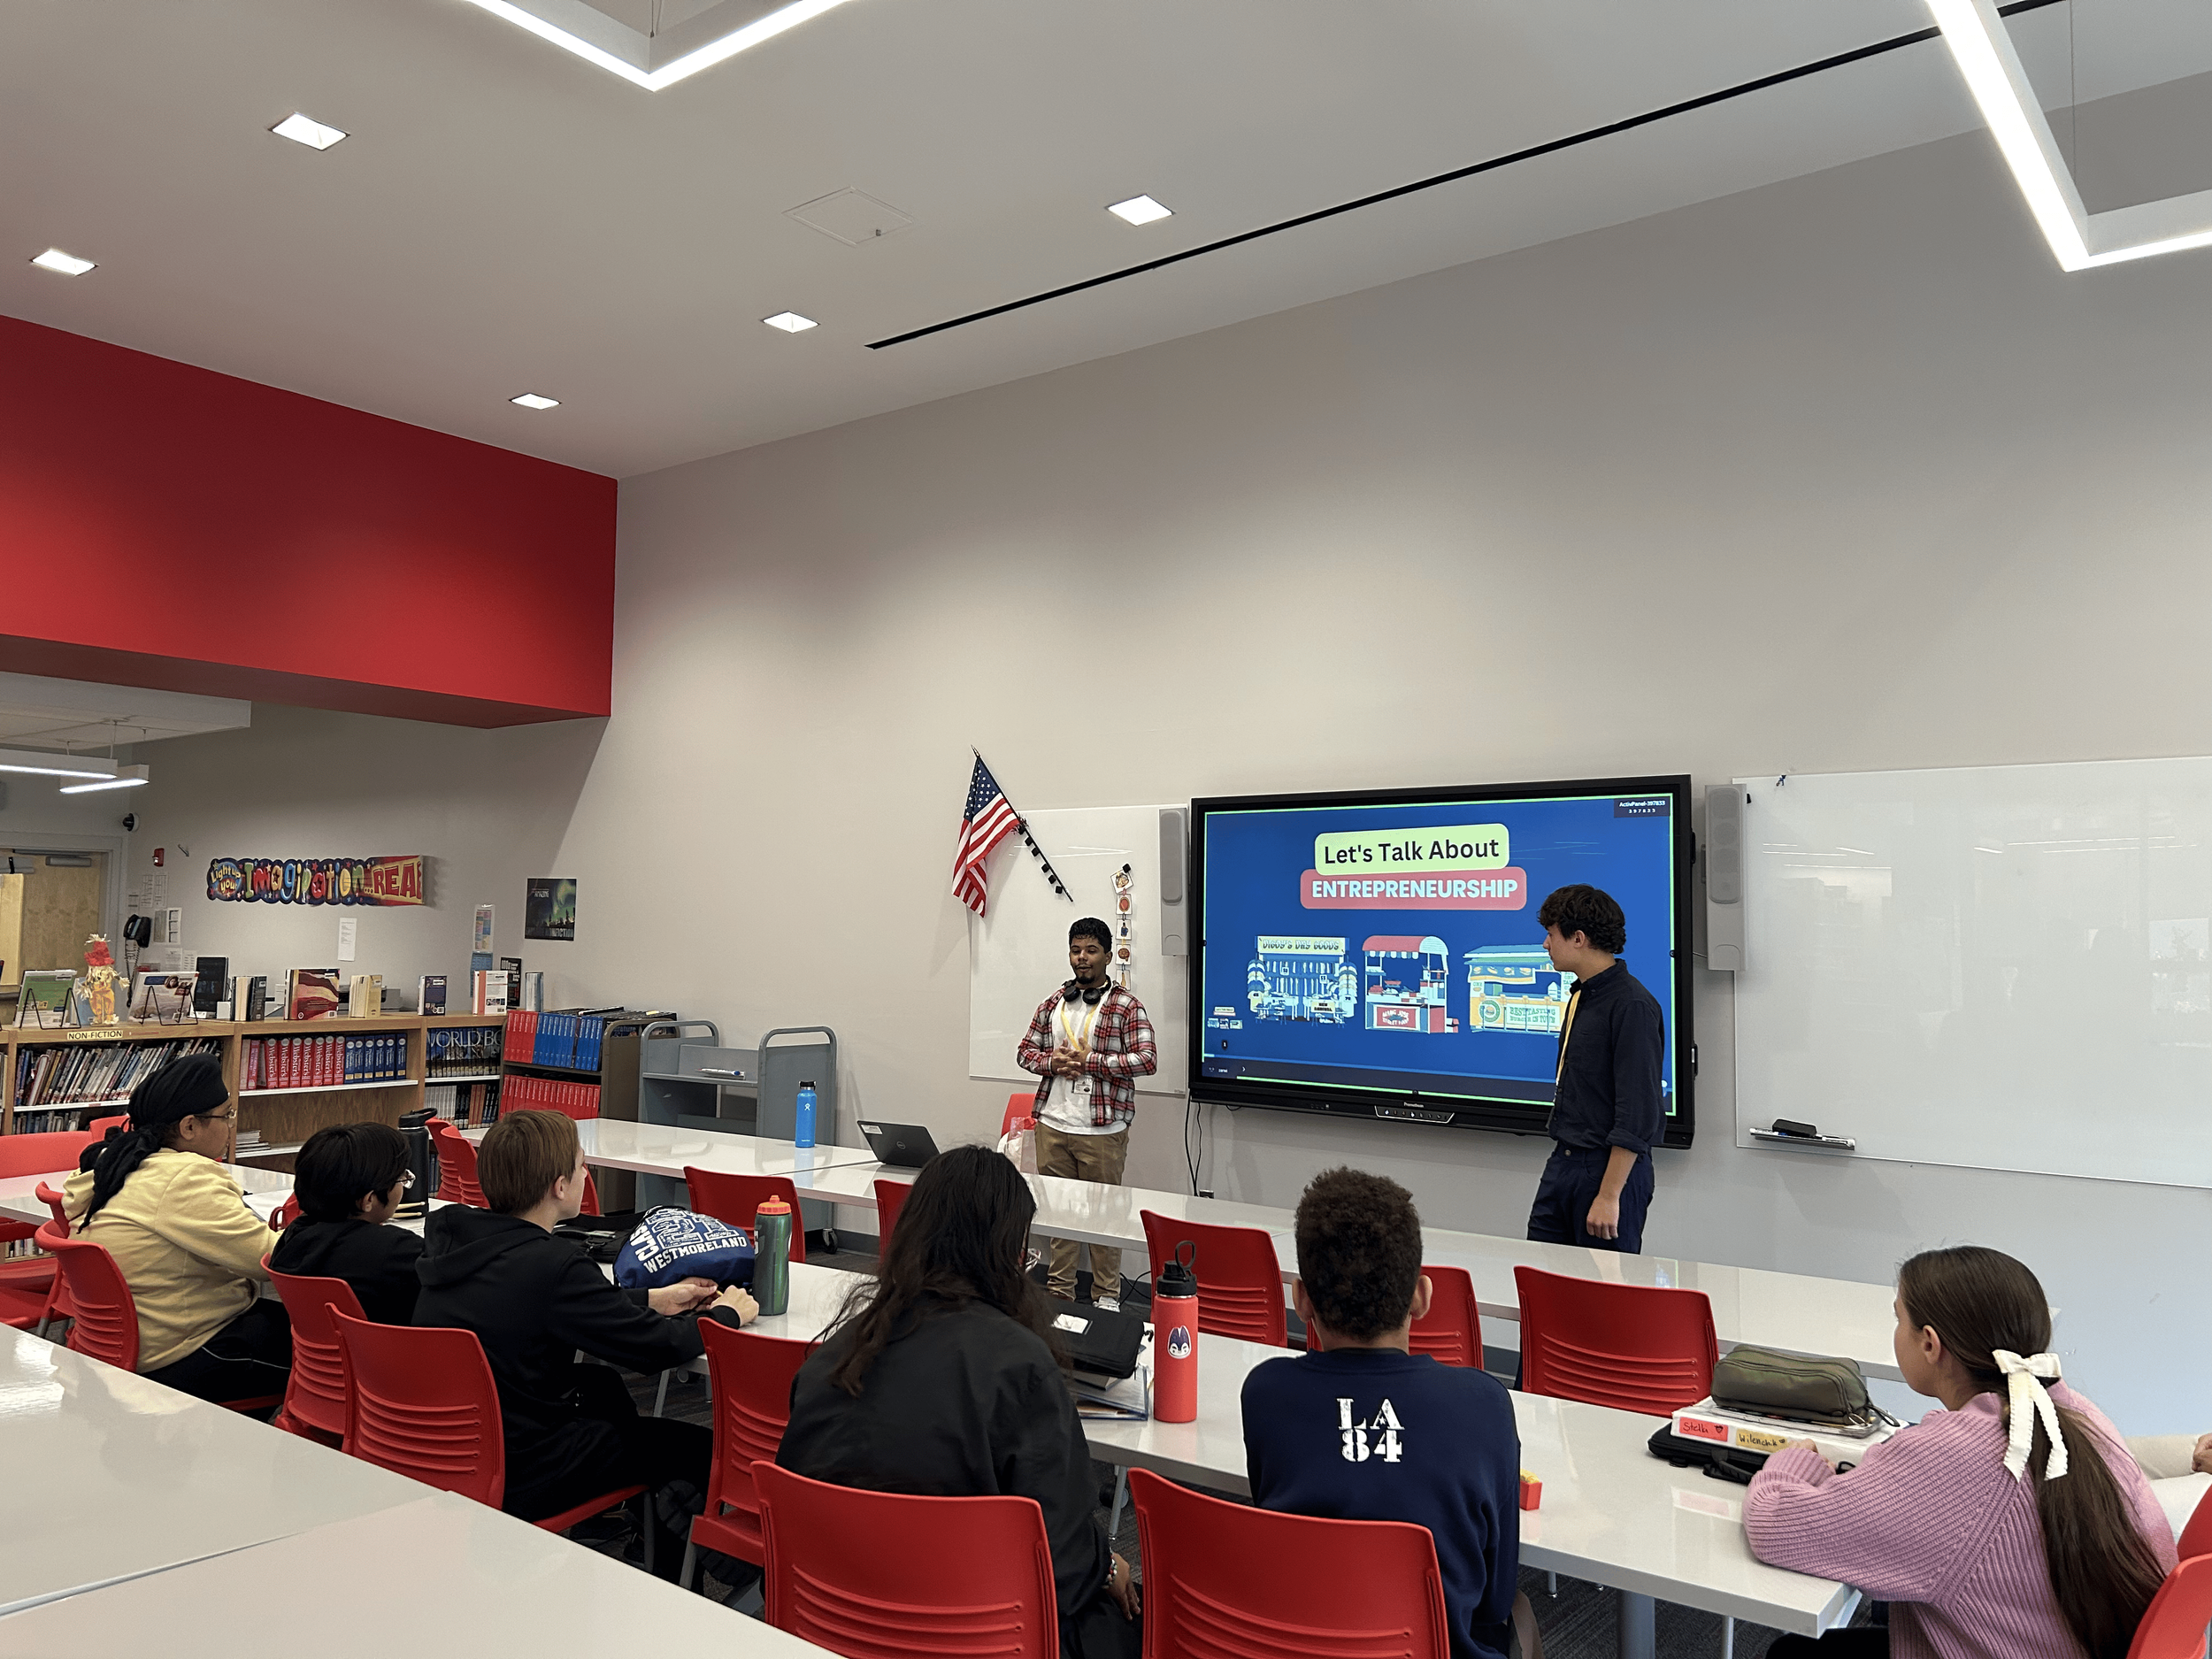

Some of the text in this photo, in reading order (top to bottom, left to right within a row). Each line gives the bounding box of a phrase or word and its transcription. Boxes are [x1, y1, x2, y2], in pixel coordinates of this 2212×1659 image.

[1325, 839, 1499, 864] Let's Talk About
[211, 865, 231, 883] Light
[373, 861, 422, 900] REA
[1312, 879, 1518, 898] ENTREPRENEURSHIP
[1294, 939, 1311, 950] DRY
[1313, 940, 1340, 950] GOODS
[1509, 1006, 1526, 1016] BEST
[68, 1030, 122, 1040] NON-FICTION
[643, 1236, 748, 1274] WESTMORELAND
[1336, 1398, 1405, 1430] LA
[1682, 1422, 1709, 1433] Stella
[1341, 1428, 1402, 1463] 84
[1739, 1433, 1778, 1447] Wilenchik
